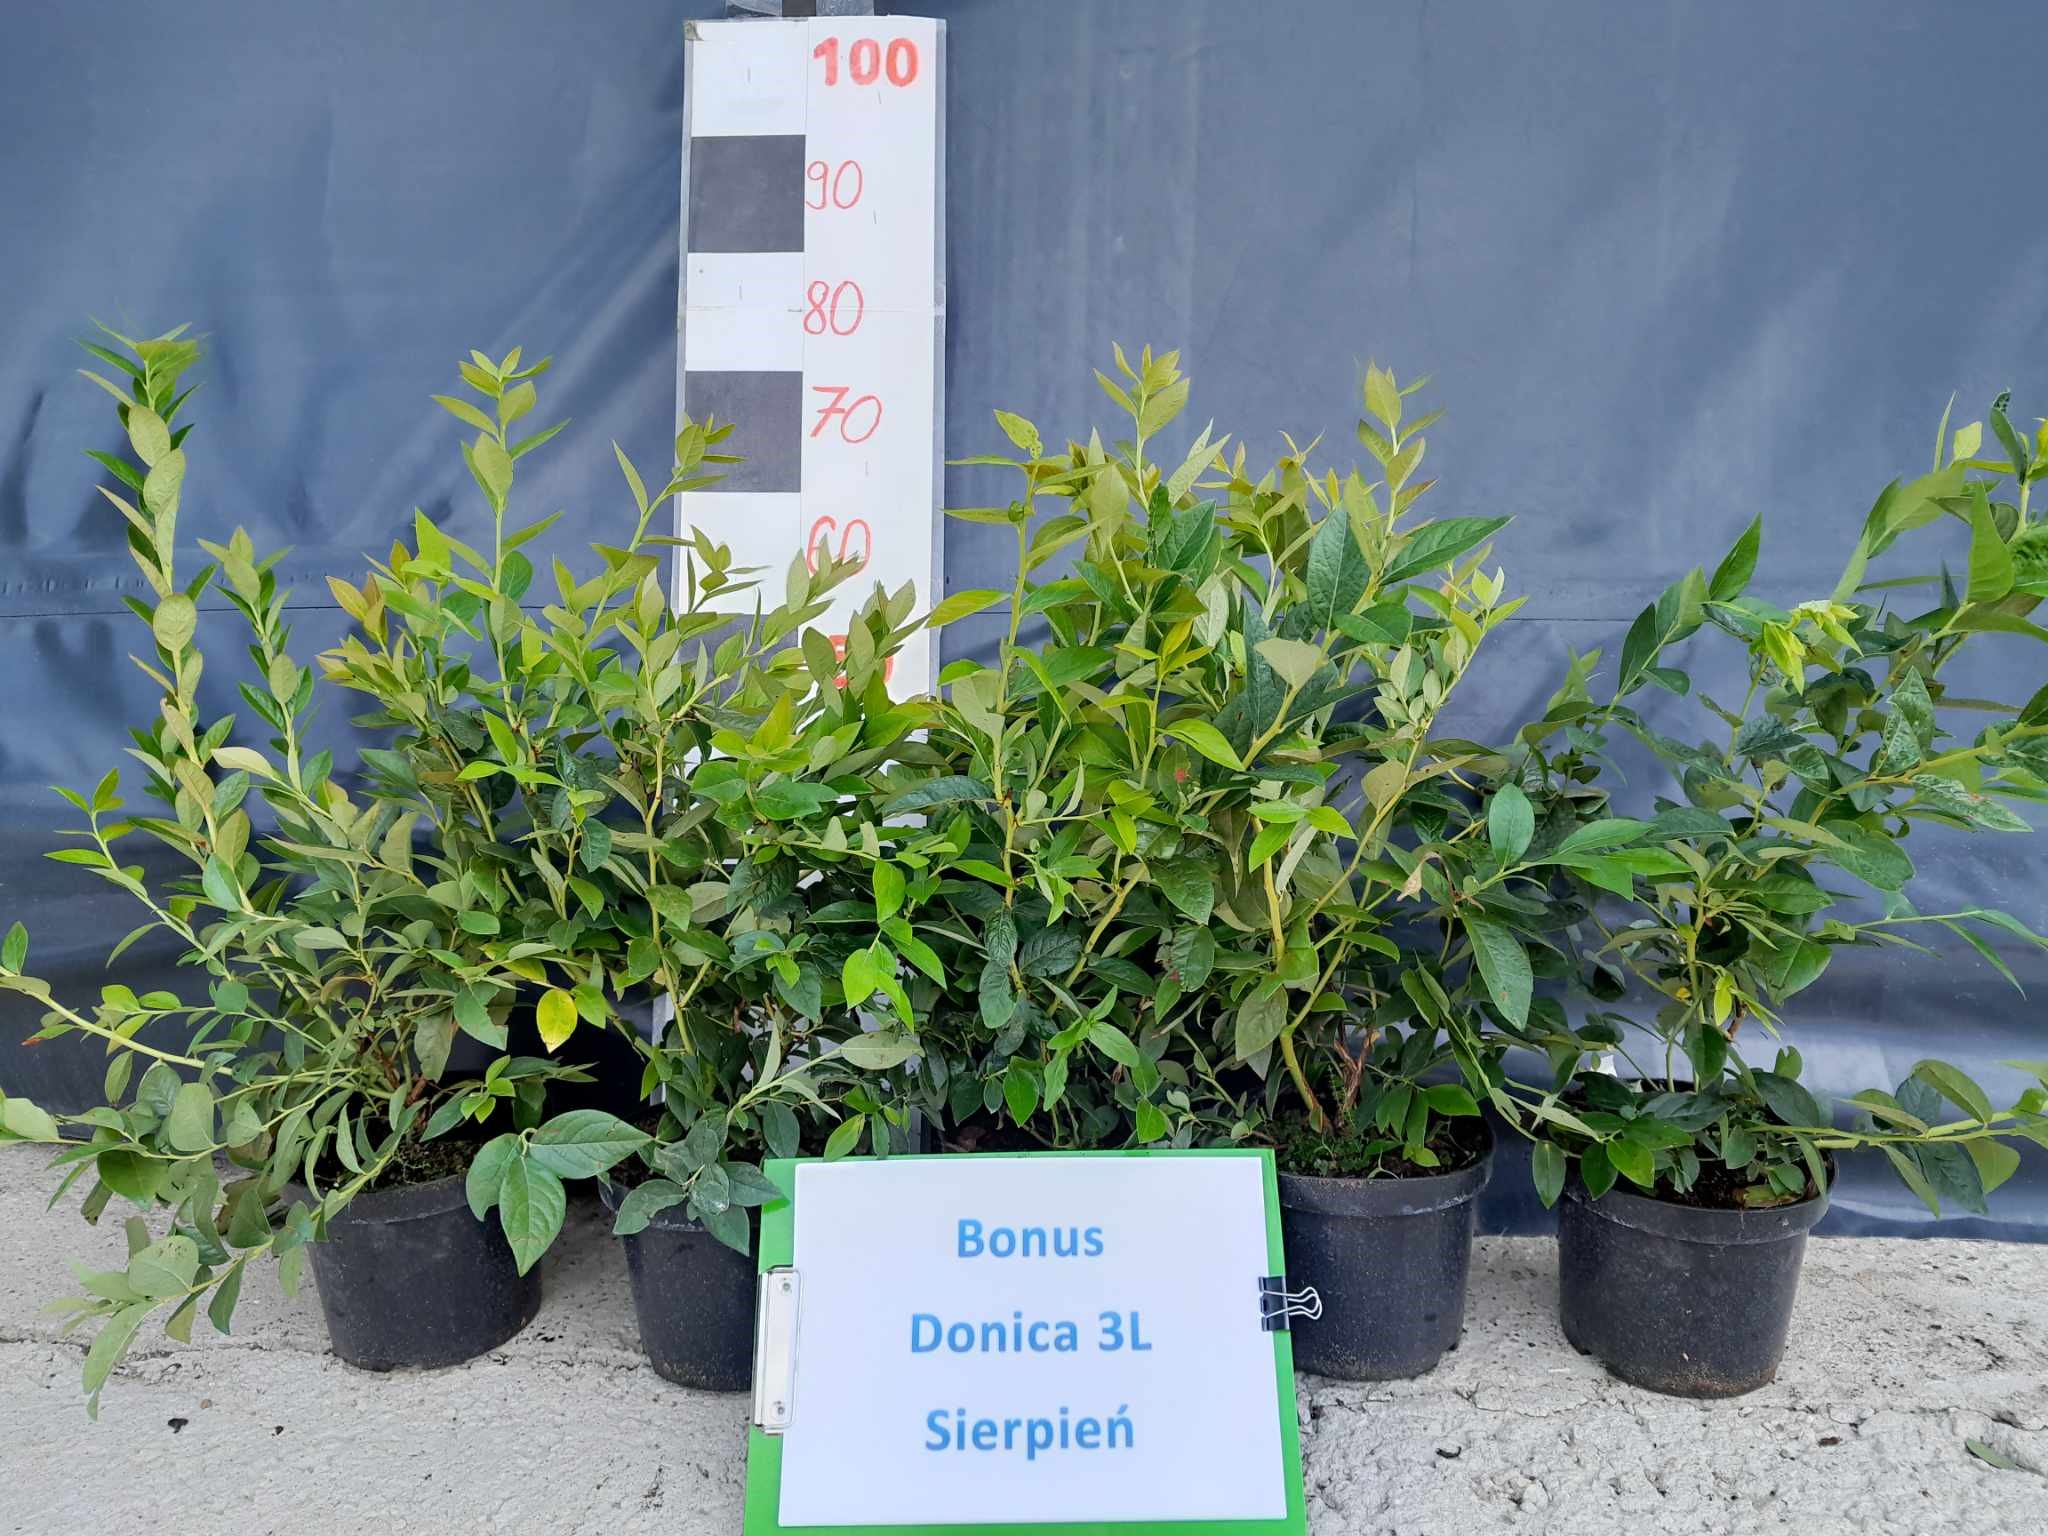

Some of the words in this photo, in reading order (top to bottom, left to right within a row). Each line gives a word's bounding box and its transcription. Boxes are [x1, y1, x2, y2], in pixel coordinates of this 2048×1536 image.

[812, 36, 920, 88] 100
[805, 159, 864, 210] 90
[802, 280, 865, 337] 80
[811, 386, 883, 444] 70
[956, 1217, 1105, 1260] Bonus
[910, 1311, 1080, 1355] Donica
[1098, 1310, 1154, 1354] 3L
[924, 1402, 1135, 1463] Sierpień
